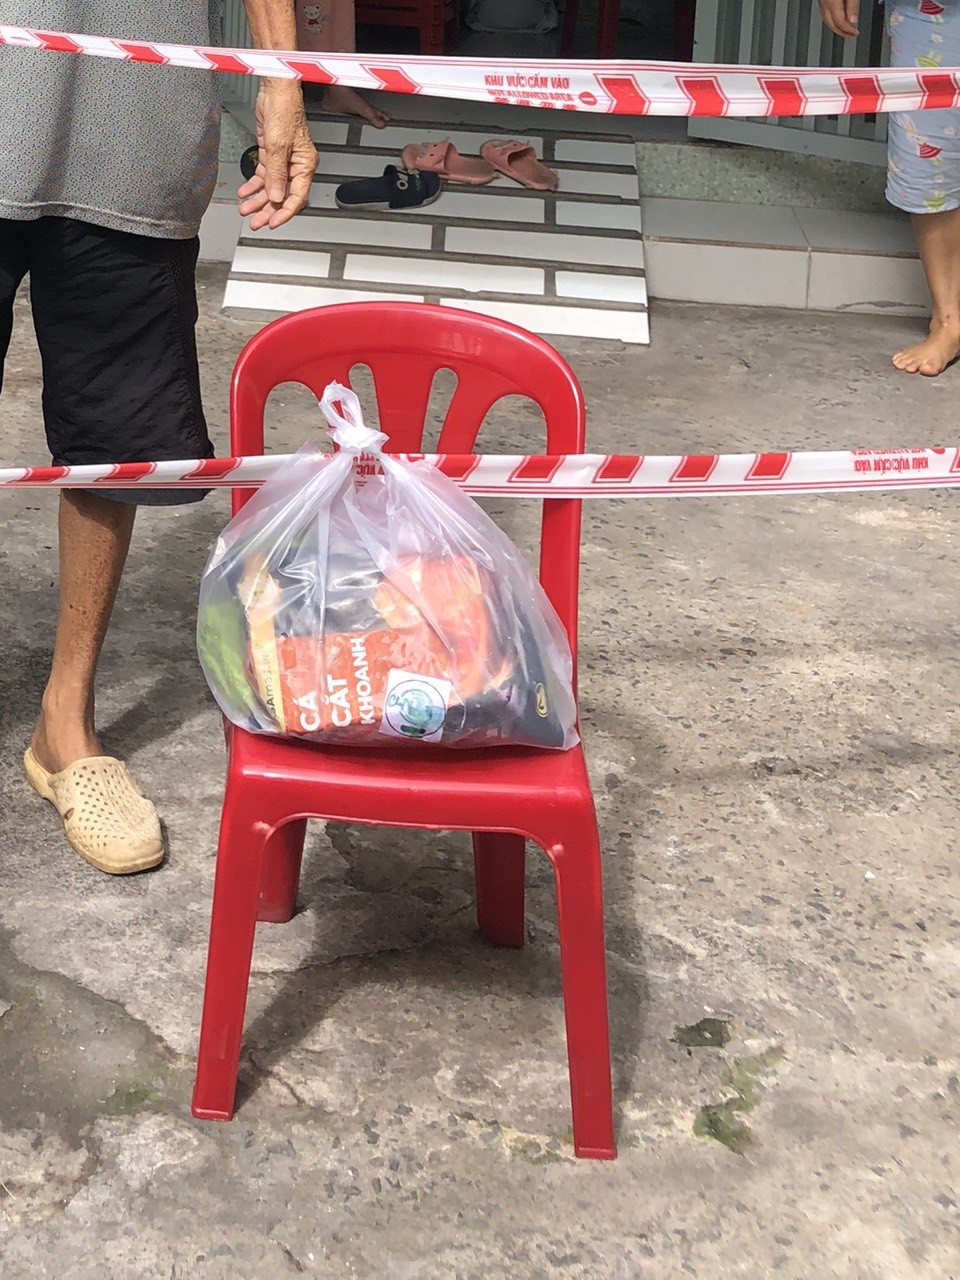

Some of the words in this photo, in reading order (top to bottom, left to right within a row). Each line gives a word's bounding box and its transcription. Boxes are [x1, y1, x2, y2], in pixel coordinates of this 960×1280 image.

[484, 74, 503, 86] KHU
[551, 74, 570, 89] VÀO
[507, 90, 548, 100] ALLOWED
[550, 92, 574, 102] AREA
[350, 637, 376, 725] KHOANH
[292, 691, 321, 731] CÁ
